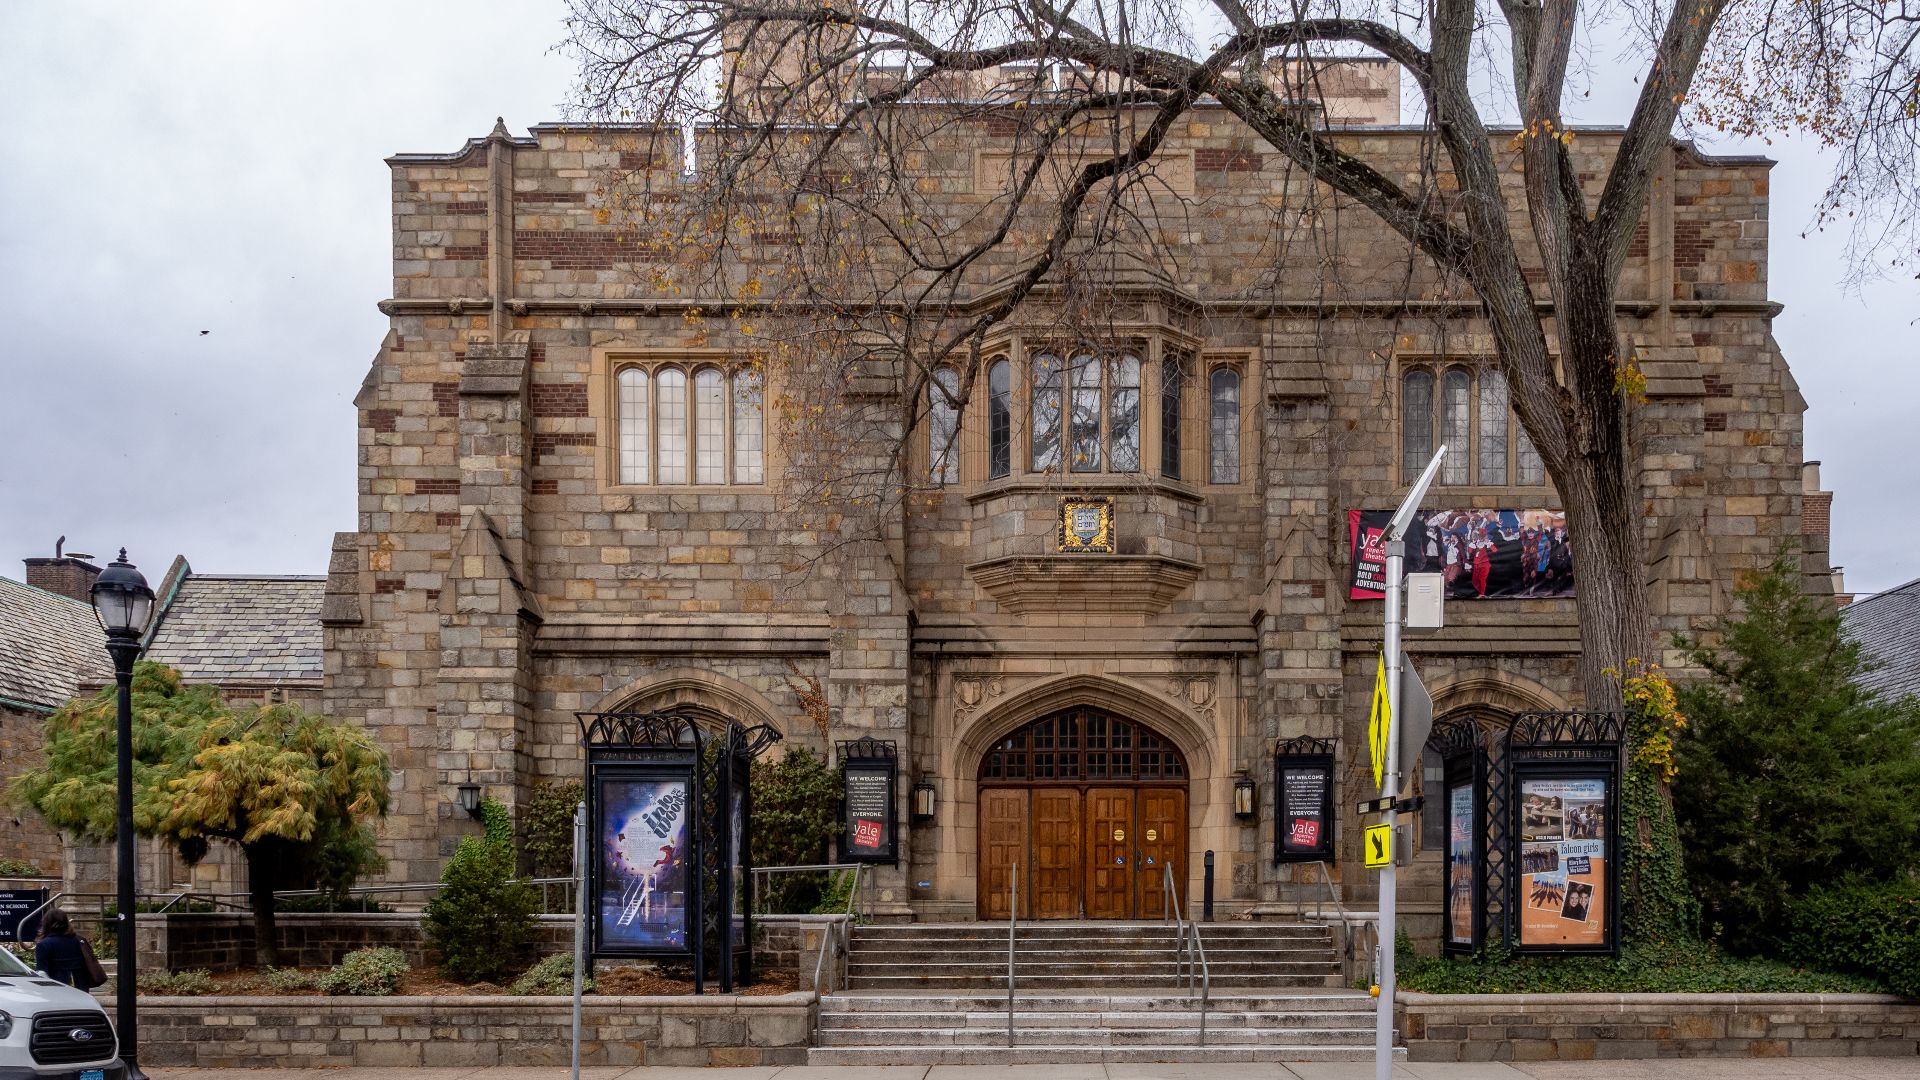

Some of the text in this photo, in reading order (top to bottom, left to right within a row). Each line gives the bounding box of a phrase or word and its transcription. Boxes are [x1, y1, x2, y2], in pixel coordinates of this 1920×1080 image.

[1360, 533, 1384, 549] ya
[1359, 562, 1380, 572] DARING
[1357, 570, 1372, 579] BOLD
[1355, 579, 1386, 590] ADVENTUR
[1512, 750, 1570, 758] UNIVERSITY
[852, 823, 878, 837] yale
[1289, 822, 1315, 835] yale
[1561, 842, 1599, 854] falcon girls
